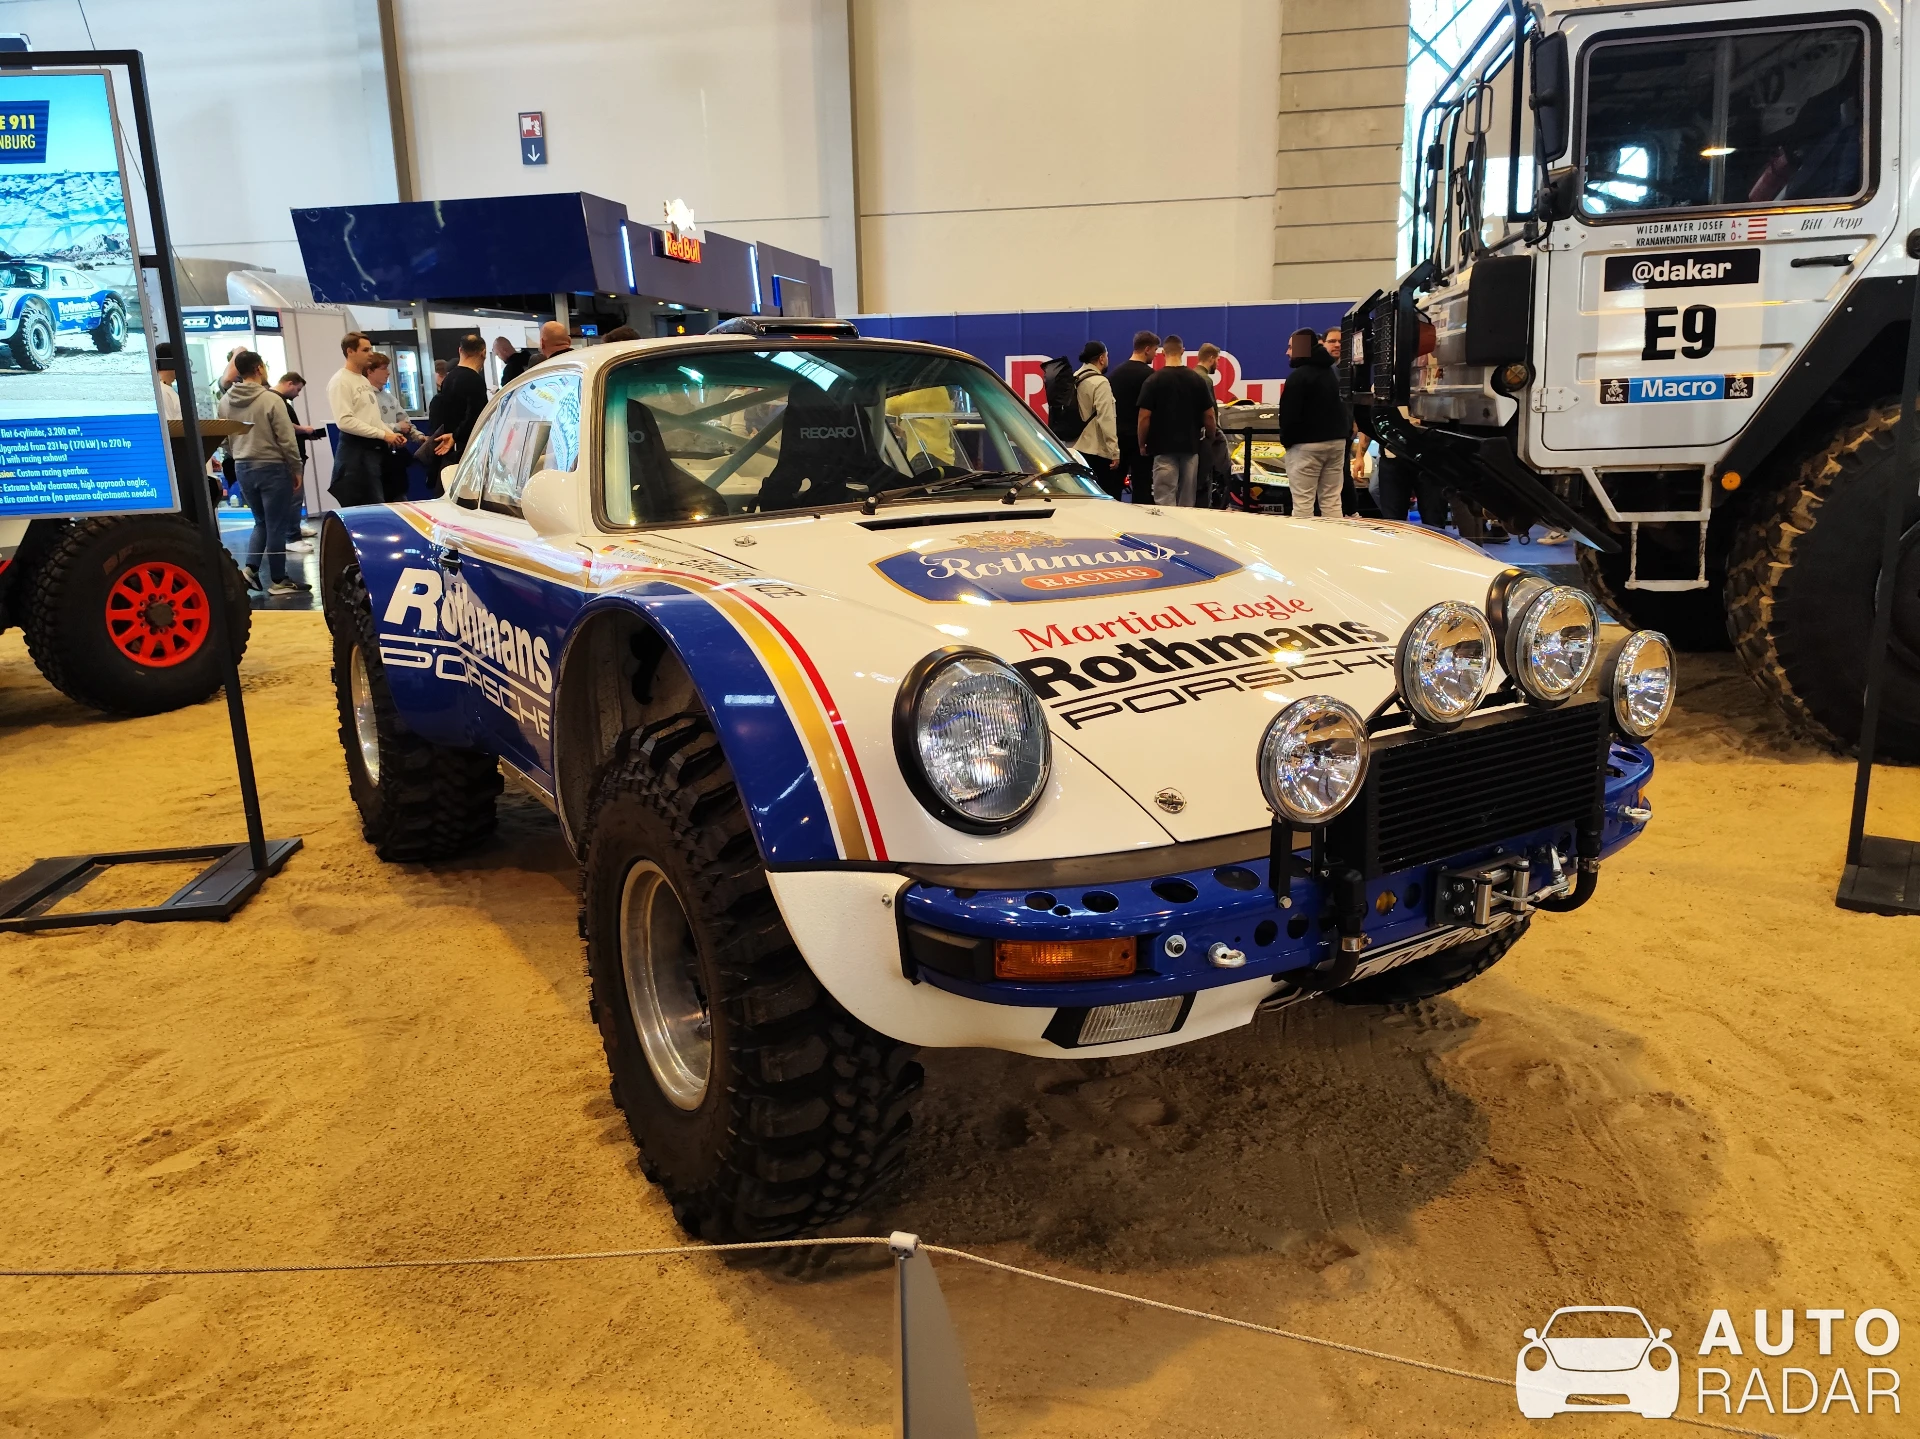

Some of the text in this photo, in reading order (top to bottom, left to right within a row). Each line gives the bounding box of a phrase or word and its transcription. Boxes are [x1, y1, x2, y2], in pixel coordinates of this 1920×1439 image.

[9, 114, 35, 130] 911
[1636, 222, 1694, 235] WIEDEMAYER
[1697, 220, 1724, 231] JOSEF
[1800, 217, 1824, 231] Bill
[666, 230, 701, 262] Red Bull
[1636, 233, 1698, 247] KRANAWENDTNER
[1699, 232, 1726, 243] WALTER
[1632, 258, 1732, 283] @dakar
[1641, 304, 1717, 361] E9
[1641, 379, 1717, 398] Macro
[47, 427, 67, 437] 3.200
[799, 426, 857, 440] RECARO
[30, 441, 46, 452] from
[46, 441, 59, 451] 231
[59, 440, 69, 452] hp
[101, 441, 108, 449] to
[108, 438, 122, 448] 270
[122, 438, 132, 449] hp
[6, 454, 20, 464] with
[21, 454, 42, 465] racing
[42, 452, 68, 463] exhaust
[17, 468, 41, 478] Custom
[41, 467, 62, 477] racing
[62, 465, 89, 478] gearbox
[3, 483, 30, 493] Extreme
[30, 481, 47, 492] belly
[47, 480, 80, 491] clearance,
[80, 478, 96, 490] high
[96, 477, 126, 490] approach
[126, 476, 150, 487] angles,
[16, 494, 39, 503] contact
[40, 494, 51, 503] are
[52, 491, 63, 503] (no
[64, 492, 92, 503] pressure
[92, 490, 131, 501] adjustments
[131, 487, 157, 499] needed)
[919, 542, 1190, 580] Rothmans
[1034, 567, 1150, 589] RACING
[383, 567, 553, 694] Rothmans
[1014, 594, 1314, 653] Martial Eagle
[1011, 620, 1391, 701] Rothmans
[380, 646, 550, 741] PORSCHE
